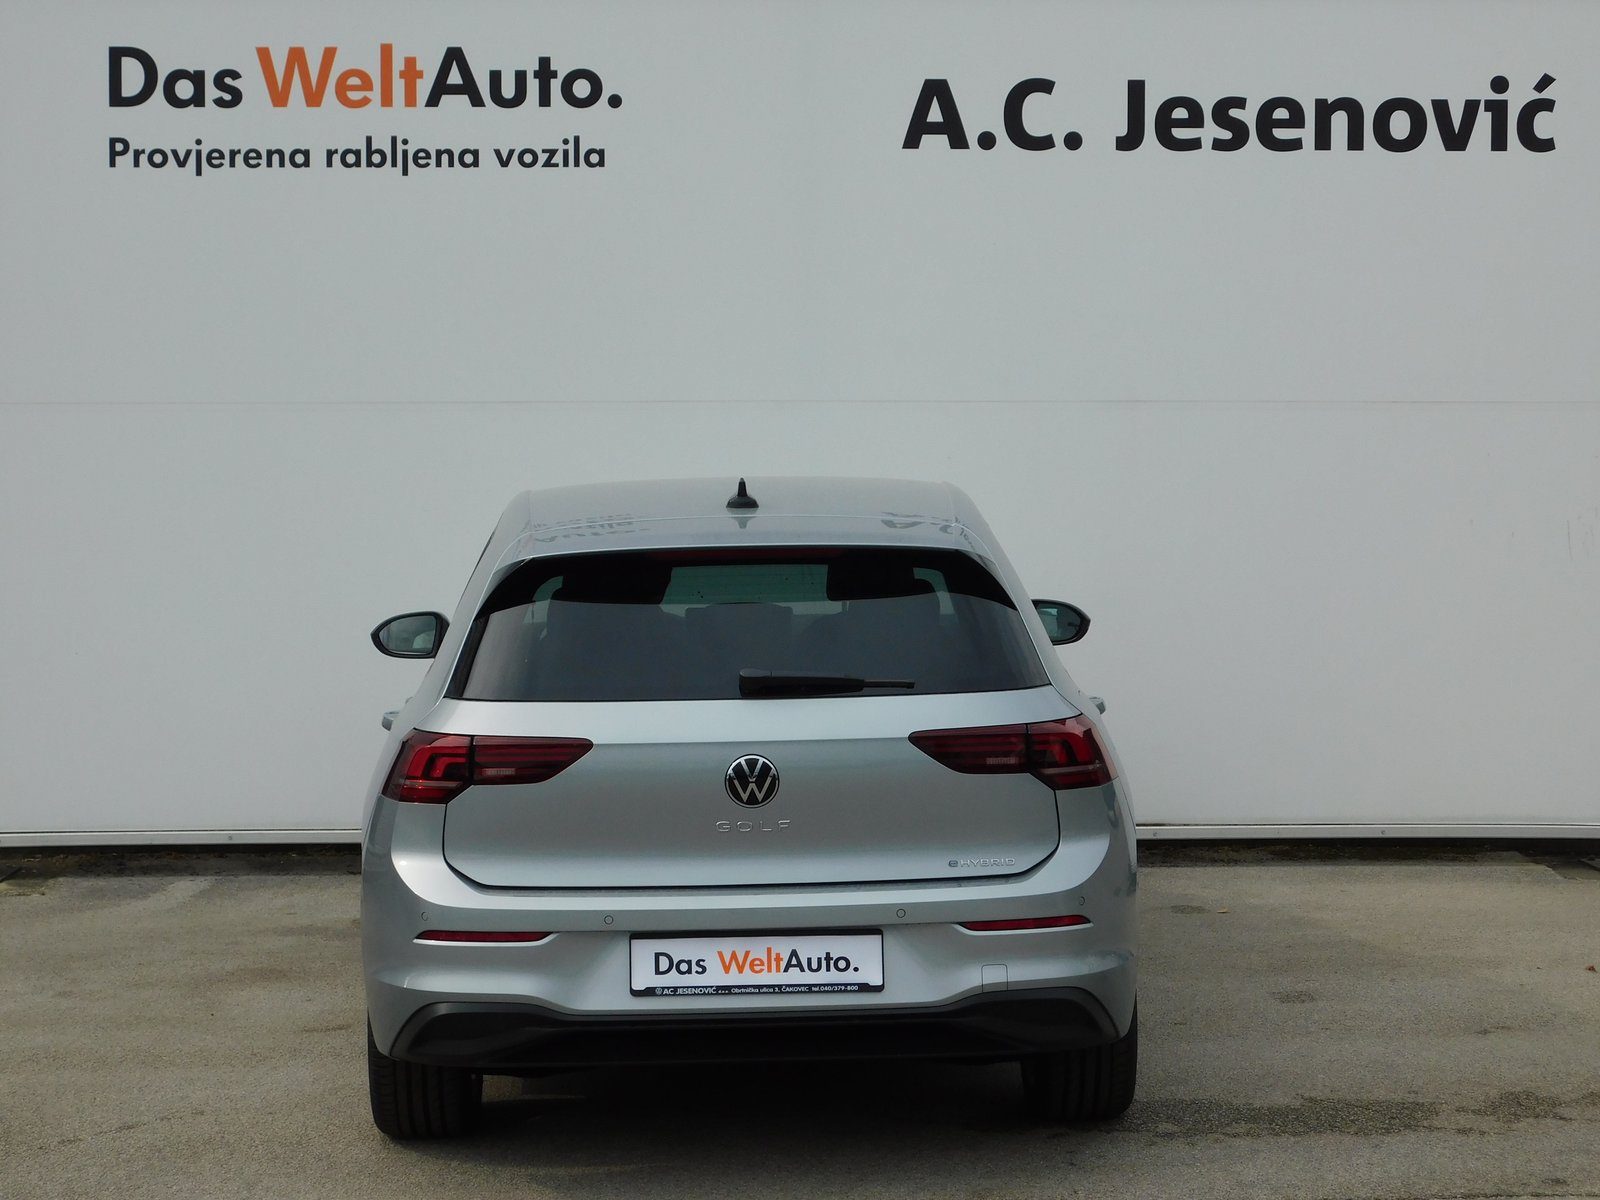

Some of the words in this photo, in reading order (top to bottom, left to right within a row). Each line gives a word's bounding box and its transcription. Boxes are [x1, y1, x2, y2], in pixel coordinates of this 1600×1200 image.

[108, 46, 244, 109] Das
[255, 42, 623, 110] WeltAuto.
[902, 77, 1084, 152] A.C.
[1115, 73, 1557, 154] Jesenović
[108, 136, 311, 177] Provjerena
[325, 135, 480, 177] rabljena
[492, 134, 606, 169] vozila
[715, 819, 792, 833] GOLF
[654, 951, 707, 976] Das
[717, 946, 860, 975] WeltAuto.
[676, 986, 717, 995] JESENOVIĆ
